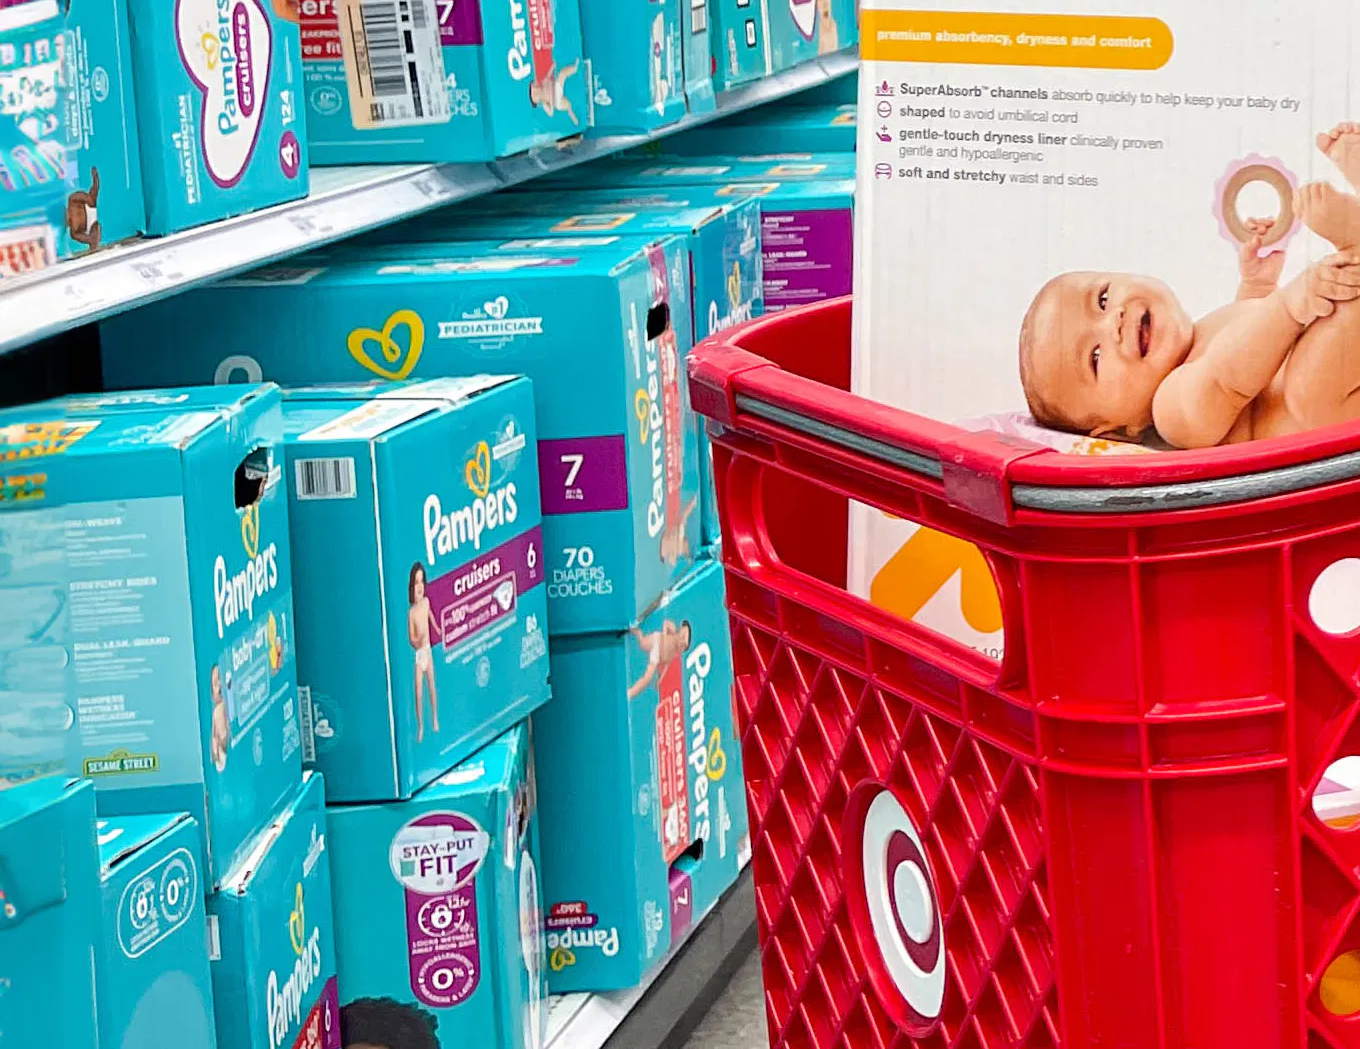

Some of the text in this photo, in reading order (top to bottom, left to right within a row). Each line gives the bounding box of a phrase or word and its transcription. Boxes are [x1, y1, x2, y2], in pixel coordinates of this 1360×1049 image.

[877, 28, 1152, 49] premium absorbency, dryness and comfort
[236, 12, 252, 108] cruisers
[281, 91, 296, 124] 124
[990, 86, 1048, 100] channels
[1052, 88, 1093, 102] absorb
[1095, 89, 1137, 106] quickly
[1140, 91, 1152, 104] to
[1155, 91, 1182, 107] help
[1184, 93, 1213, 109] keep
[1216, 96, 1244, 109] your
[1246, 95, 1278, 111] baby
[1280, 96, 1301, 112] dry
[899, 105, 1078, 124] shaped to avoid umbilical cord
[899, 127, 1163, 151] gentle-touch dryness liner clinically proven
[899, 145, 1043, 164] gentle and hypoallergenic
[898, 166, 1098, 186] soft and stretchy waist and sides
[444, 320, 537, 335] PEDIATRICIAN
[561, 454, 585, 487] 7
[423, 481, 518, 566] Pampers
[454, 557, 500, 597] cruisers
[213, 542, 278, 638] Pampers
[403, 838, 474, 859] STAY-PUT
[420, 855, 458, 877] FIT
